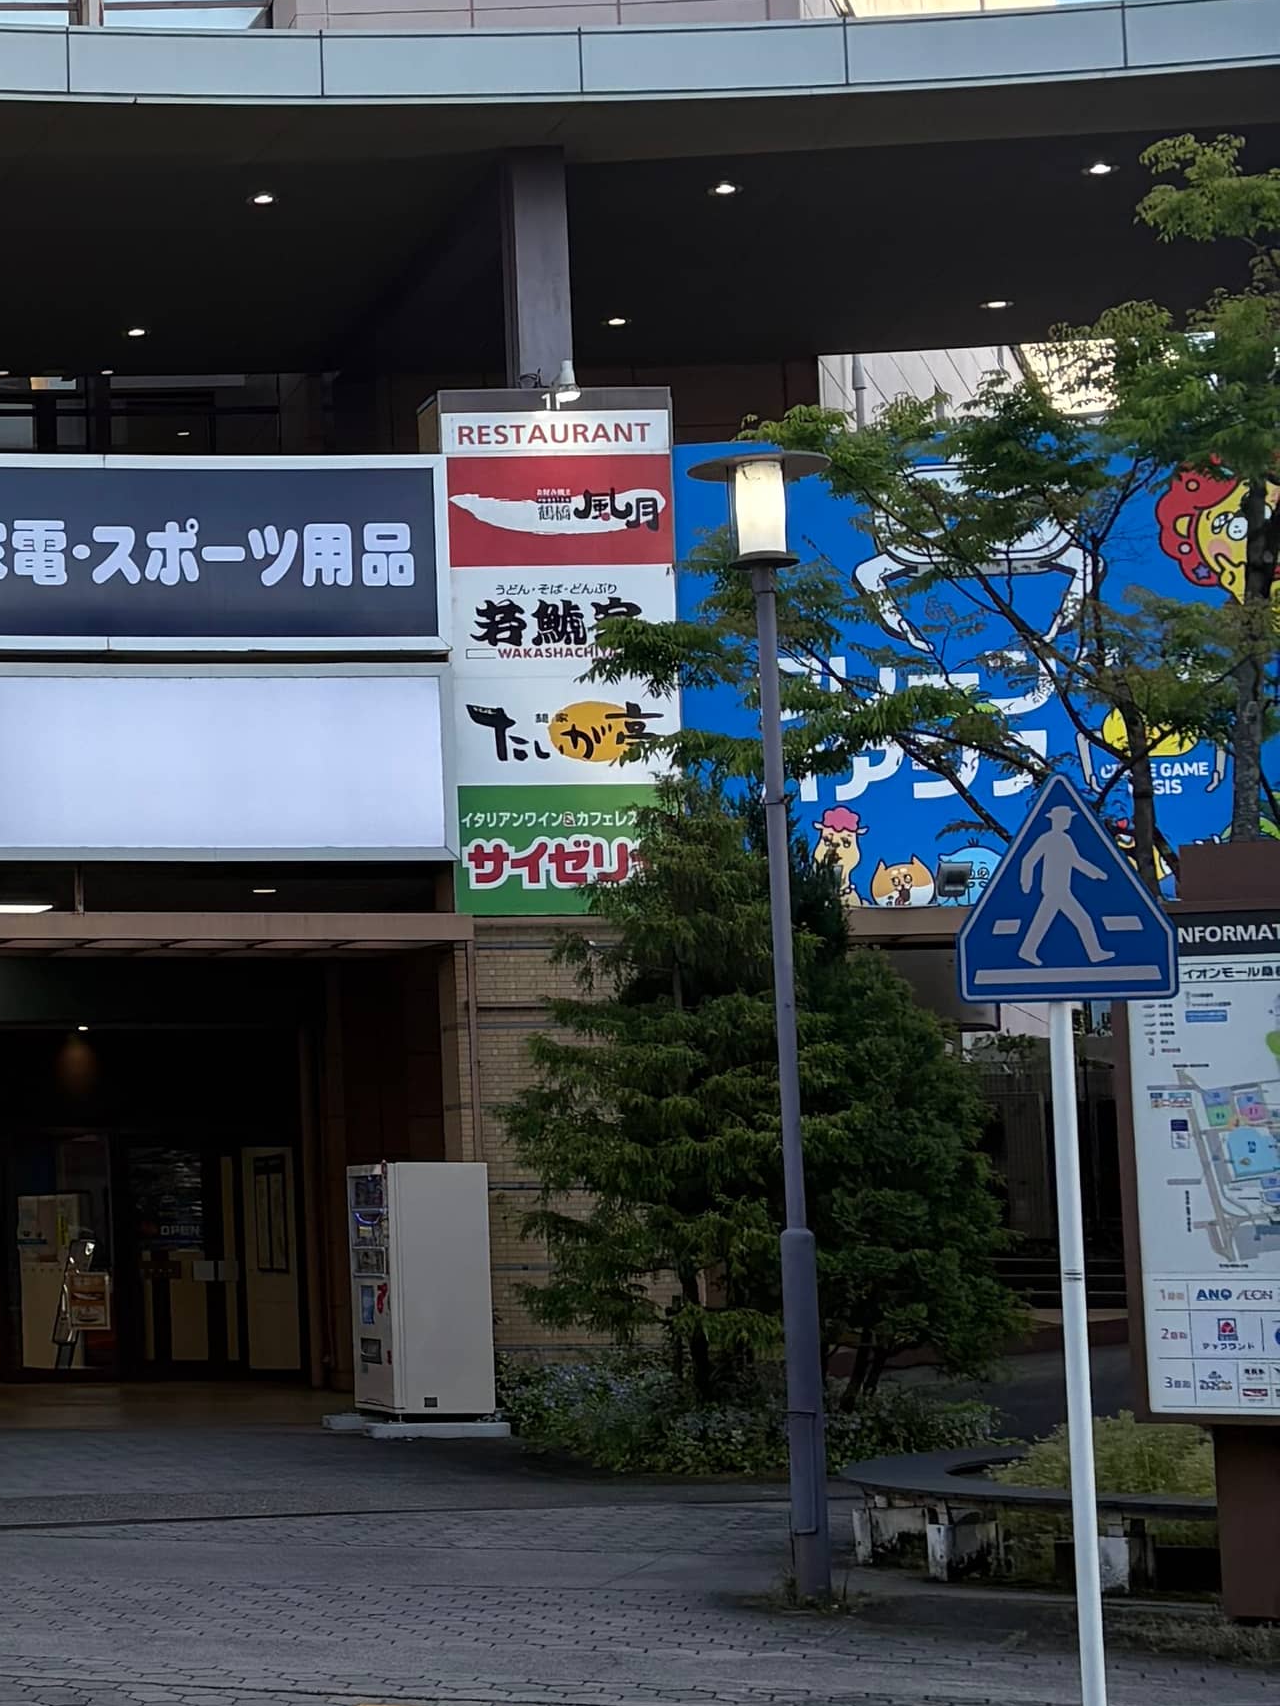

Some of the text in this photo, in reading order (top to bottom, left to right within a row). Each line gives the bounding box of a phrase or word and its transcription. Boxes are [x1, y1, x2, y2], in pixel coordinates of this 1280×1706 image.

[457, 423, 651, 445] RESTAURANT
[573, 487, 659, 531] 風月
[1160, 762, 1209, 777] GAME
[461, 811, 638, 828] イタリアンワイン&カフェレス
[1178, 923, 1280, 944] NFORMAT
